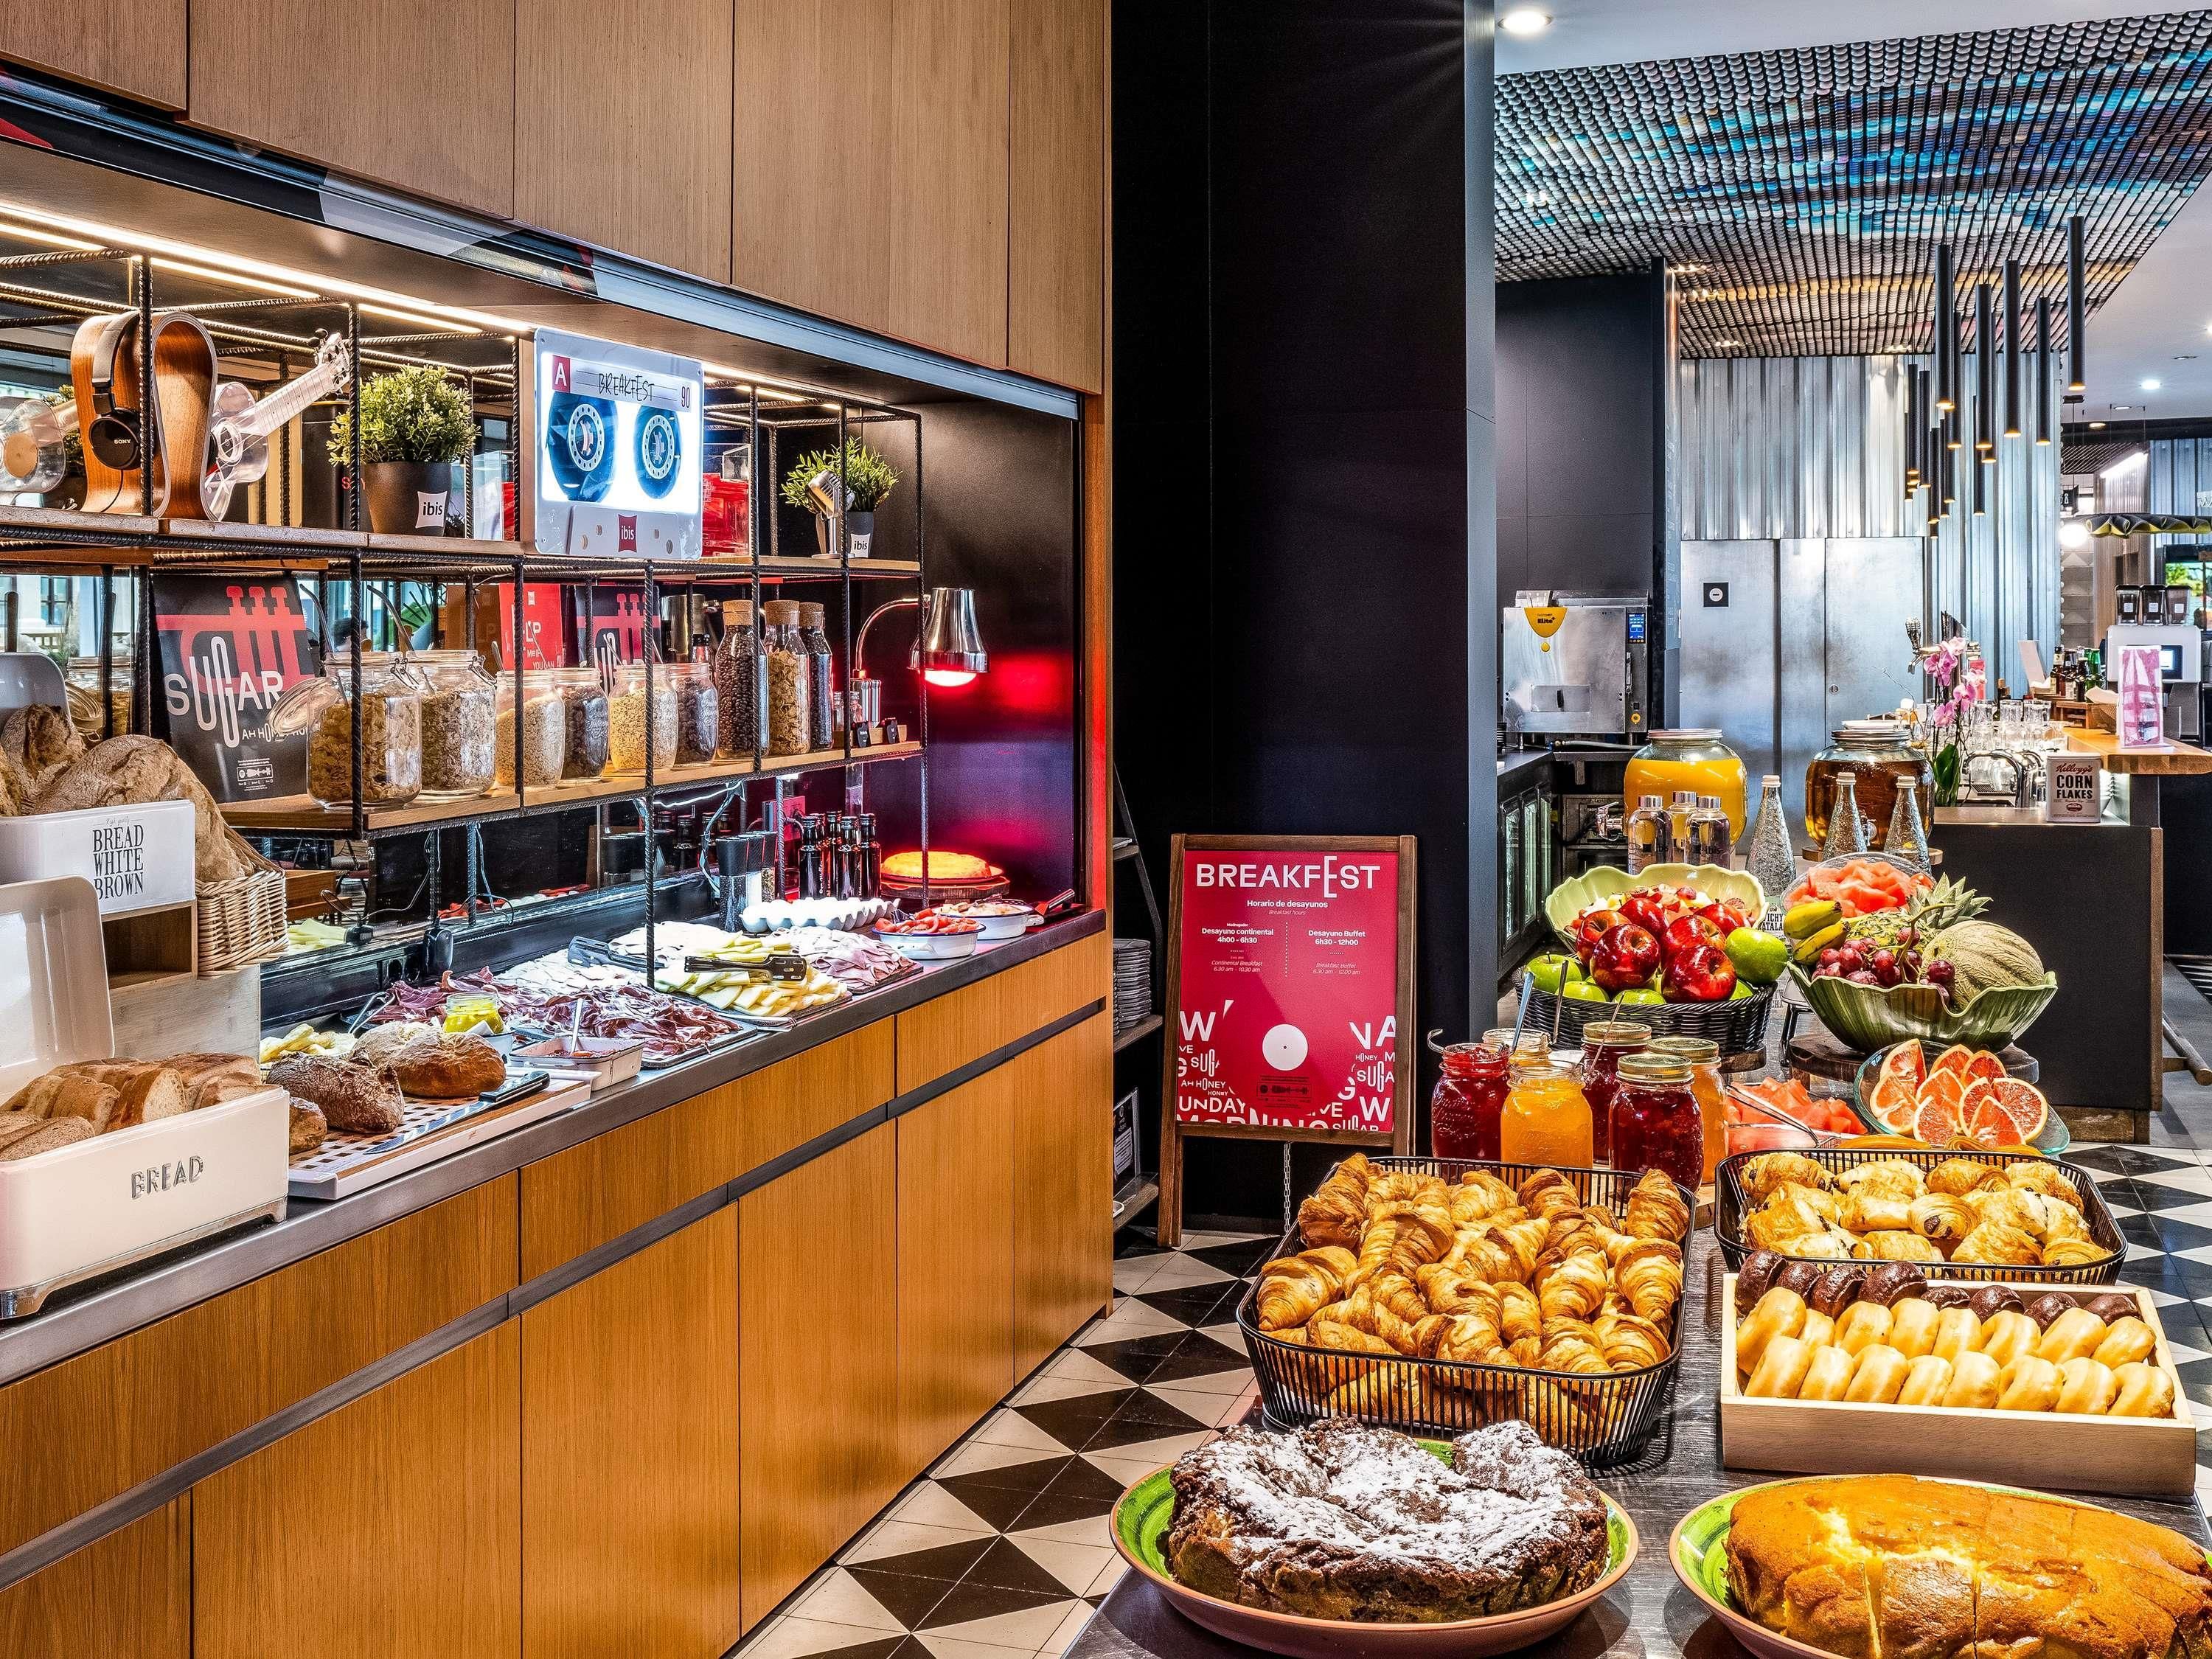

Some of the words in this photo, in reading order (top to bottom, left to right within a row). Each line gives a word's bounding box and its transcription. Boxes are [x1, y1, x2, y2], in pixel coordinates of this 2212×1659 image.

[554, 362, 568, 386] A
[598, 372, 655, 402] BREAKFEST
[681, 386, 691, 408] 90
[422, 502, 443, 515] ibis
[621, 525, 635, 540] ibis
[854, 540, 868, 550] ibis
[164, 636, 284, 748] SUGAR
[242, 728, 257, 740] AH
[2056, 763, 2093, 774] Kellogg's
[2056, 775, 2093, 788] CORN
[2056, 789, 2093, 799] FLAKES
[93, 824, 144, 852] BREAD
[93, 848, 144, 877] WHITE
[1197, 855, 1381, 898] BREAKFEST
[93, 872, 144, 900] BROWN
[1247, 900, 1274, 908] Horario
[1287, 900, 1328, 910] desayunos
[1764, 914, 1783, 922] ICHY
[1201, 928, 1235, 936] Desayuno
[1761, 922, 1783, 932] ATALA
[1308, 930, 1343, 939] Desayuno
[1355, 1052, 1378, 1062] HONEY
[1195, 1078, 1226, 1091] HONEY
[131, 1155, 204, 1200] BREAD
